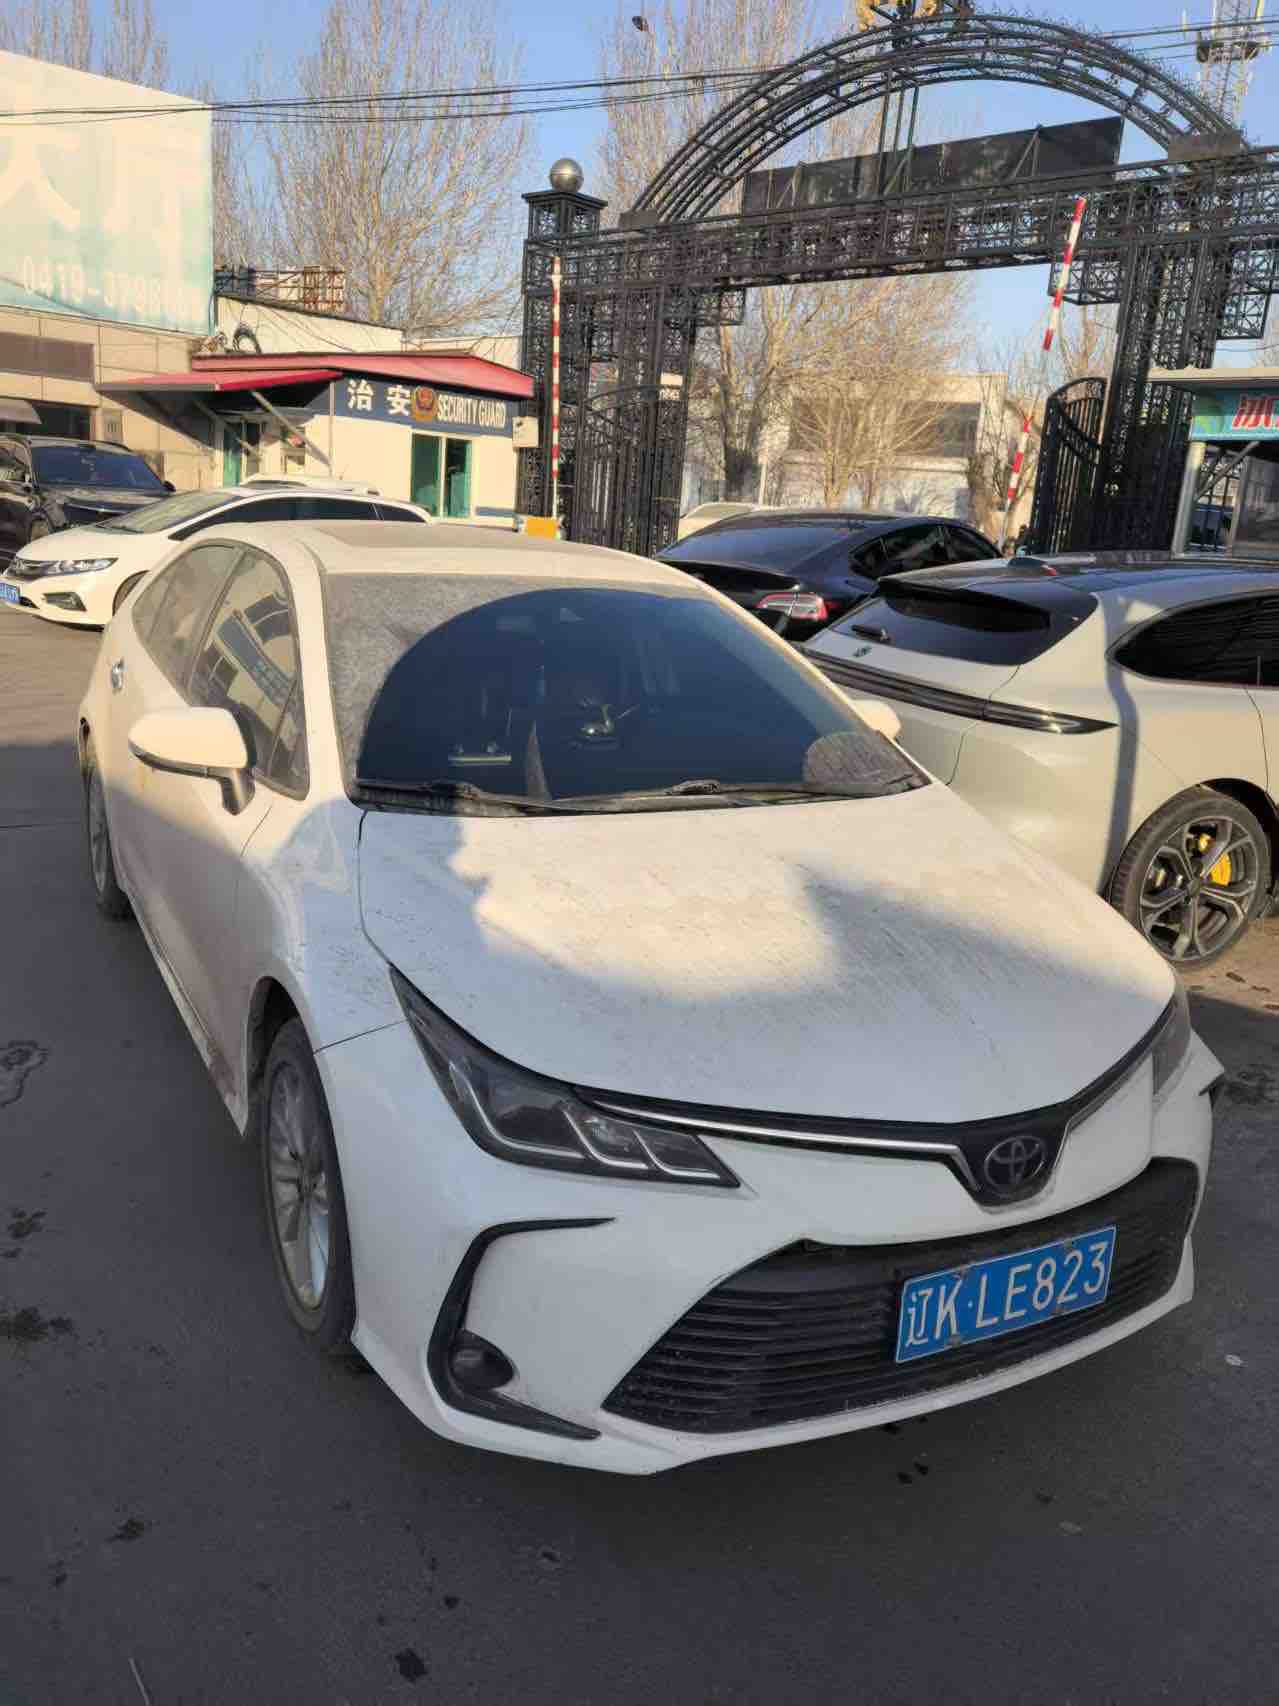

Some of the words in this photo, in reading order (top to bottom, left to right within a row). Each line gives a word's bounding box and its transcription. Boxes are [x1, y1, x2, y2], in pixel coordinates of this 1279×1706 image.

[347, 379, 411, 416] 治安
[437, 394, 478, 424] SECURITY
[478, 401, 506, 428] GUARD
